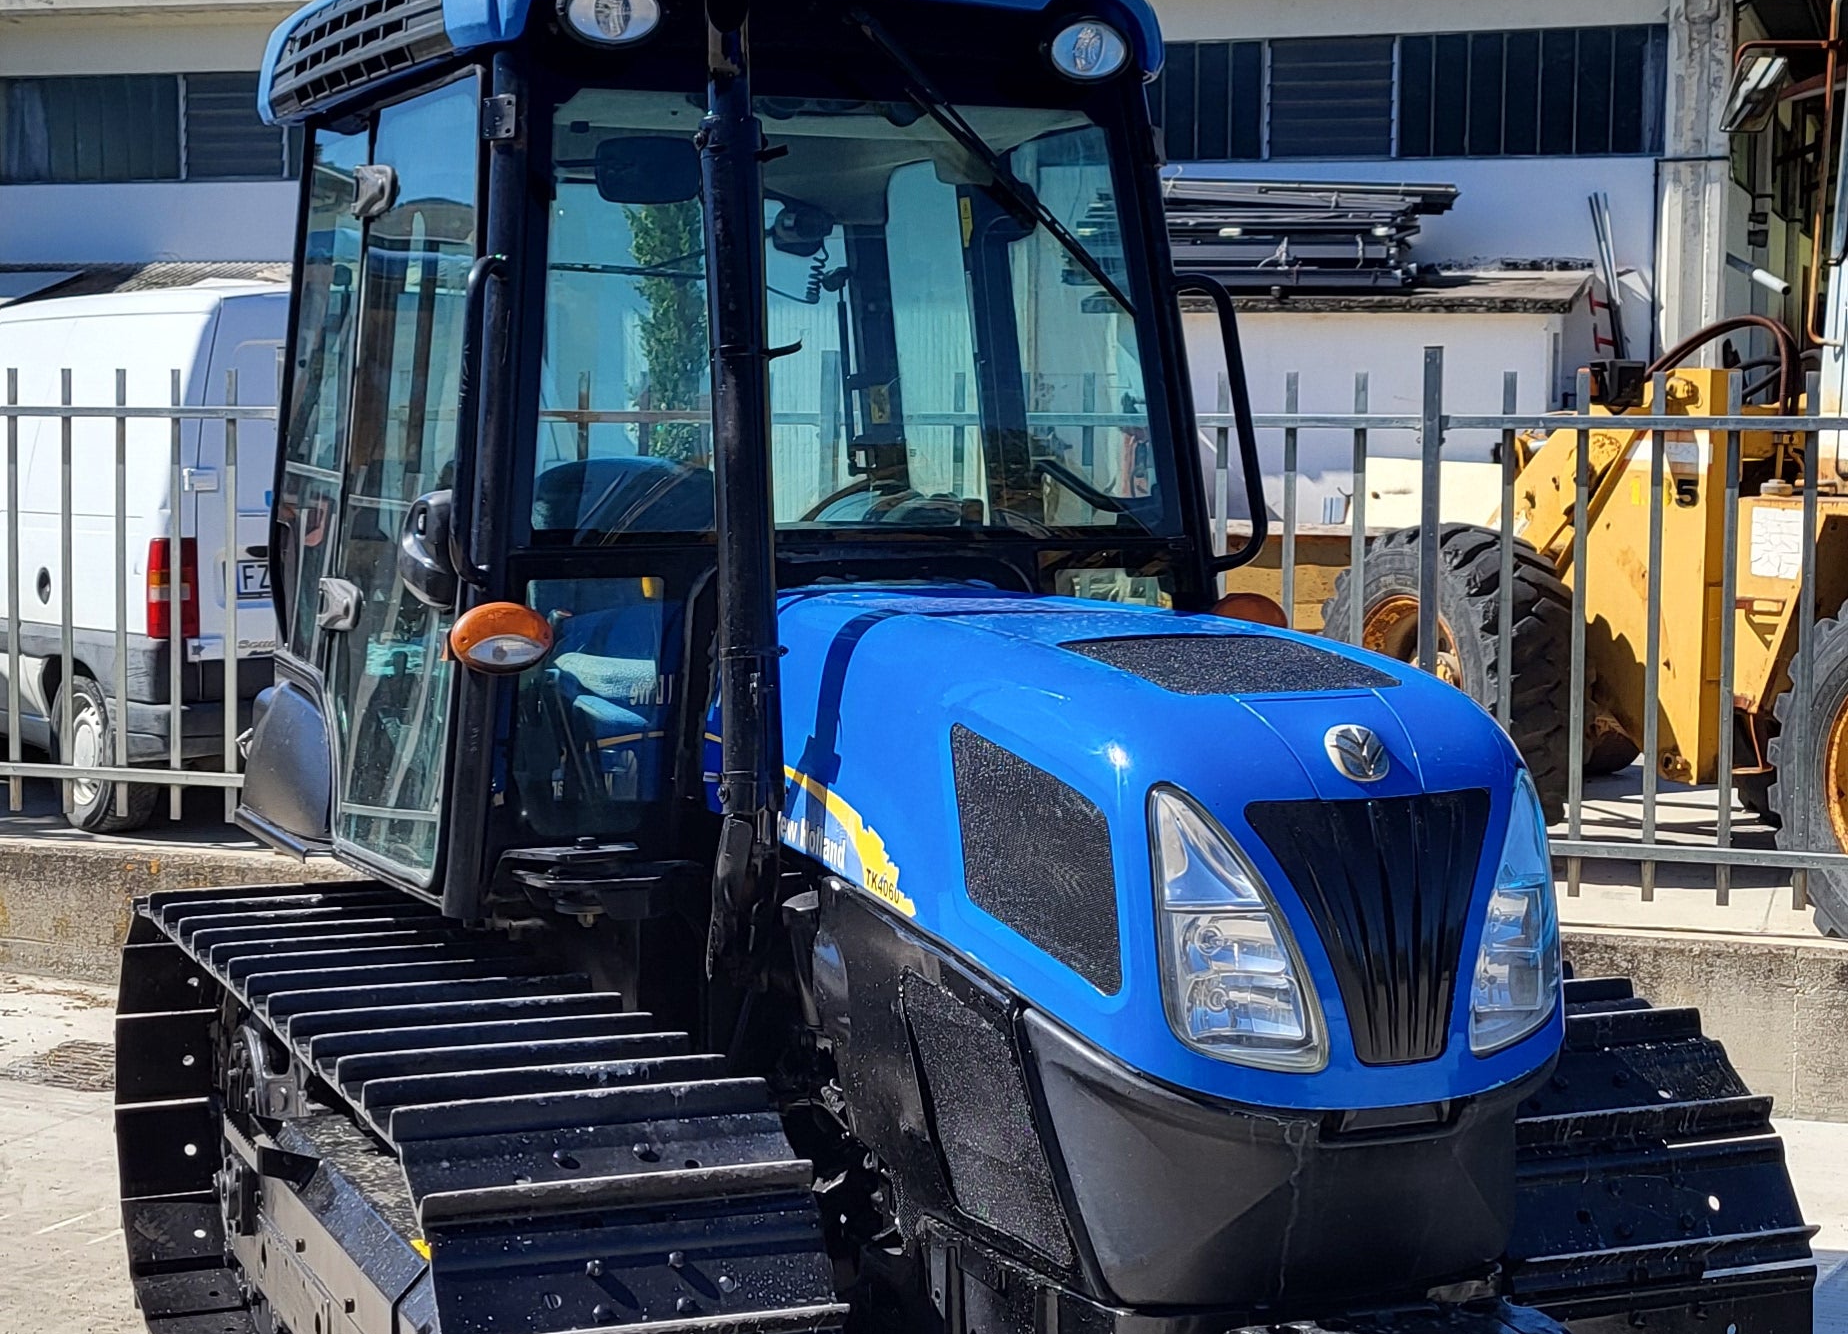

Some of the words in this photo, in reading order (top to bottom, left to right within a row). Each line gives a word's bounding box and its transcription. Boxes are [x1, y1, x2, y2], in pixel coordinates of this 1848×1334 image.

[242, 564, 271, 590] FZ
[799, 817, 847, 871] Holland
[866, 868, 900, 904] TK4060
